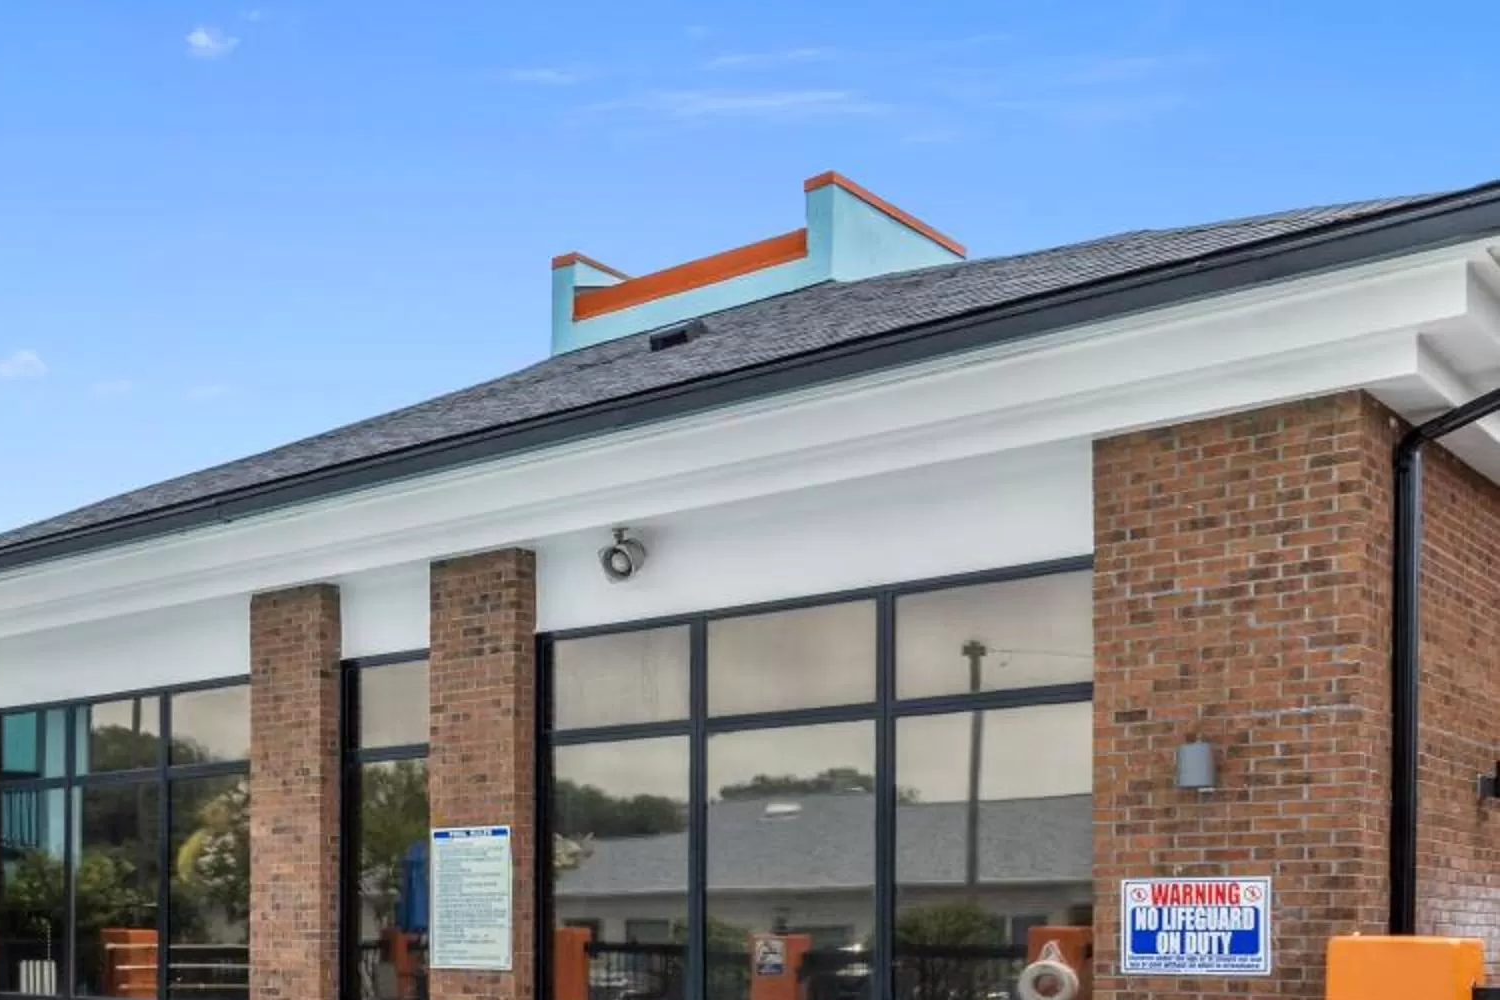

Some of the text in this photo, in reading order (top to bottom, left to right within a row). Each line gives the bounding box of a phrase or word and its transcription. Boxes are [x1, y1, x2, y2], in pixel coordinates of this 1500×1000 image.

[1151, 883, 1240, 907] WARNING
[1135, 907, 1255, 931] NO LIFEGUARD
[1156, 931, 1233, 955] ON DUTY
